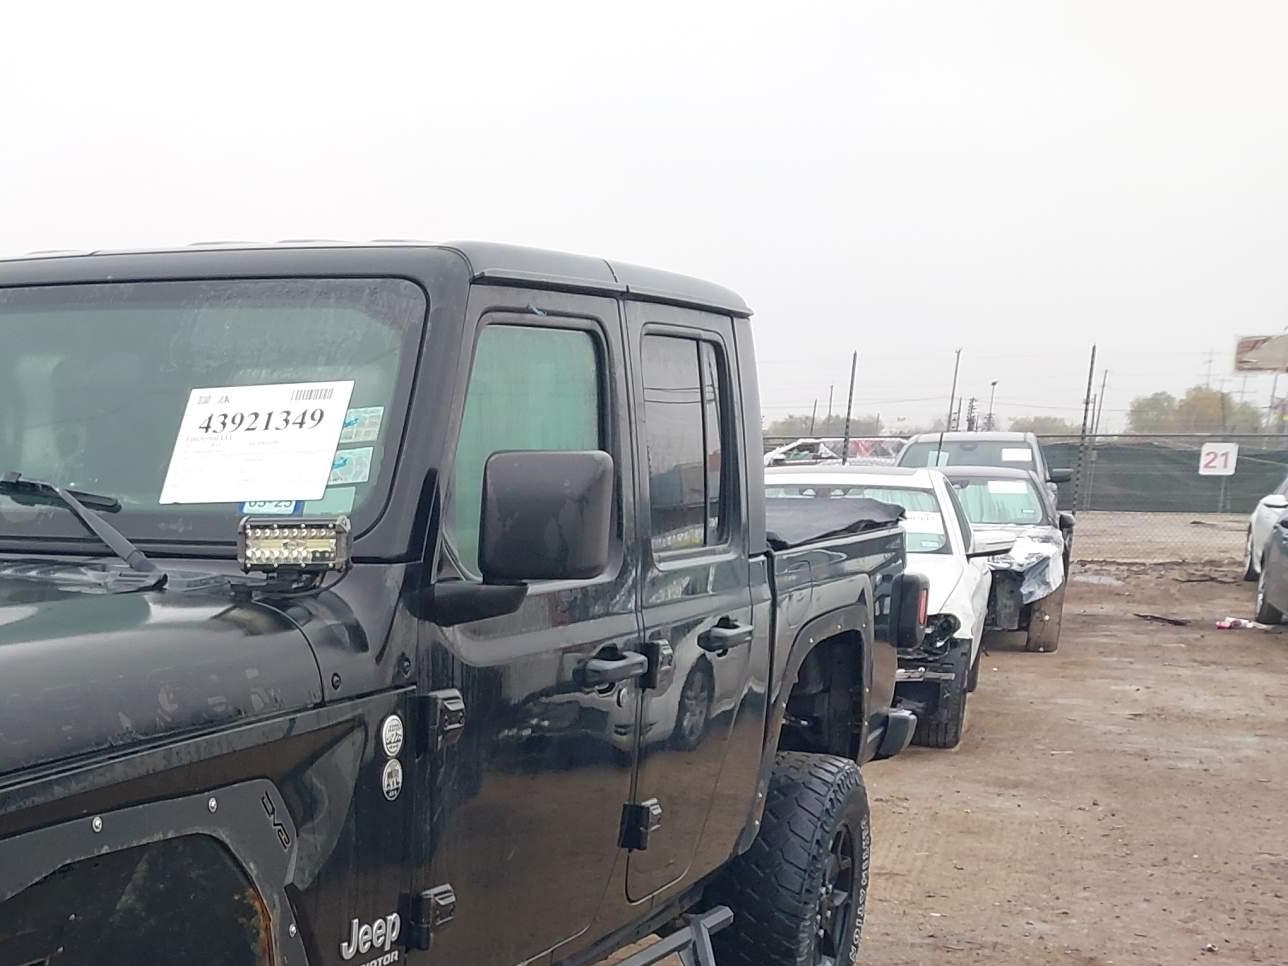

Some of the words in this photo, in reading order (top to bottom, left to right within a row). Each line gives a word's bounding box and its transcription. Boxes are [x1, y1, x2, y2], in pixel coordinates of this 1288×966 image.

[198, 408, 325, 434] 43921349
[1203, 450, 1230, 469] 21
[340, 912, 401, 960] Jeep
